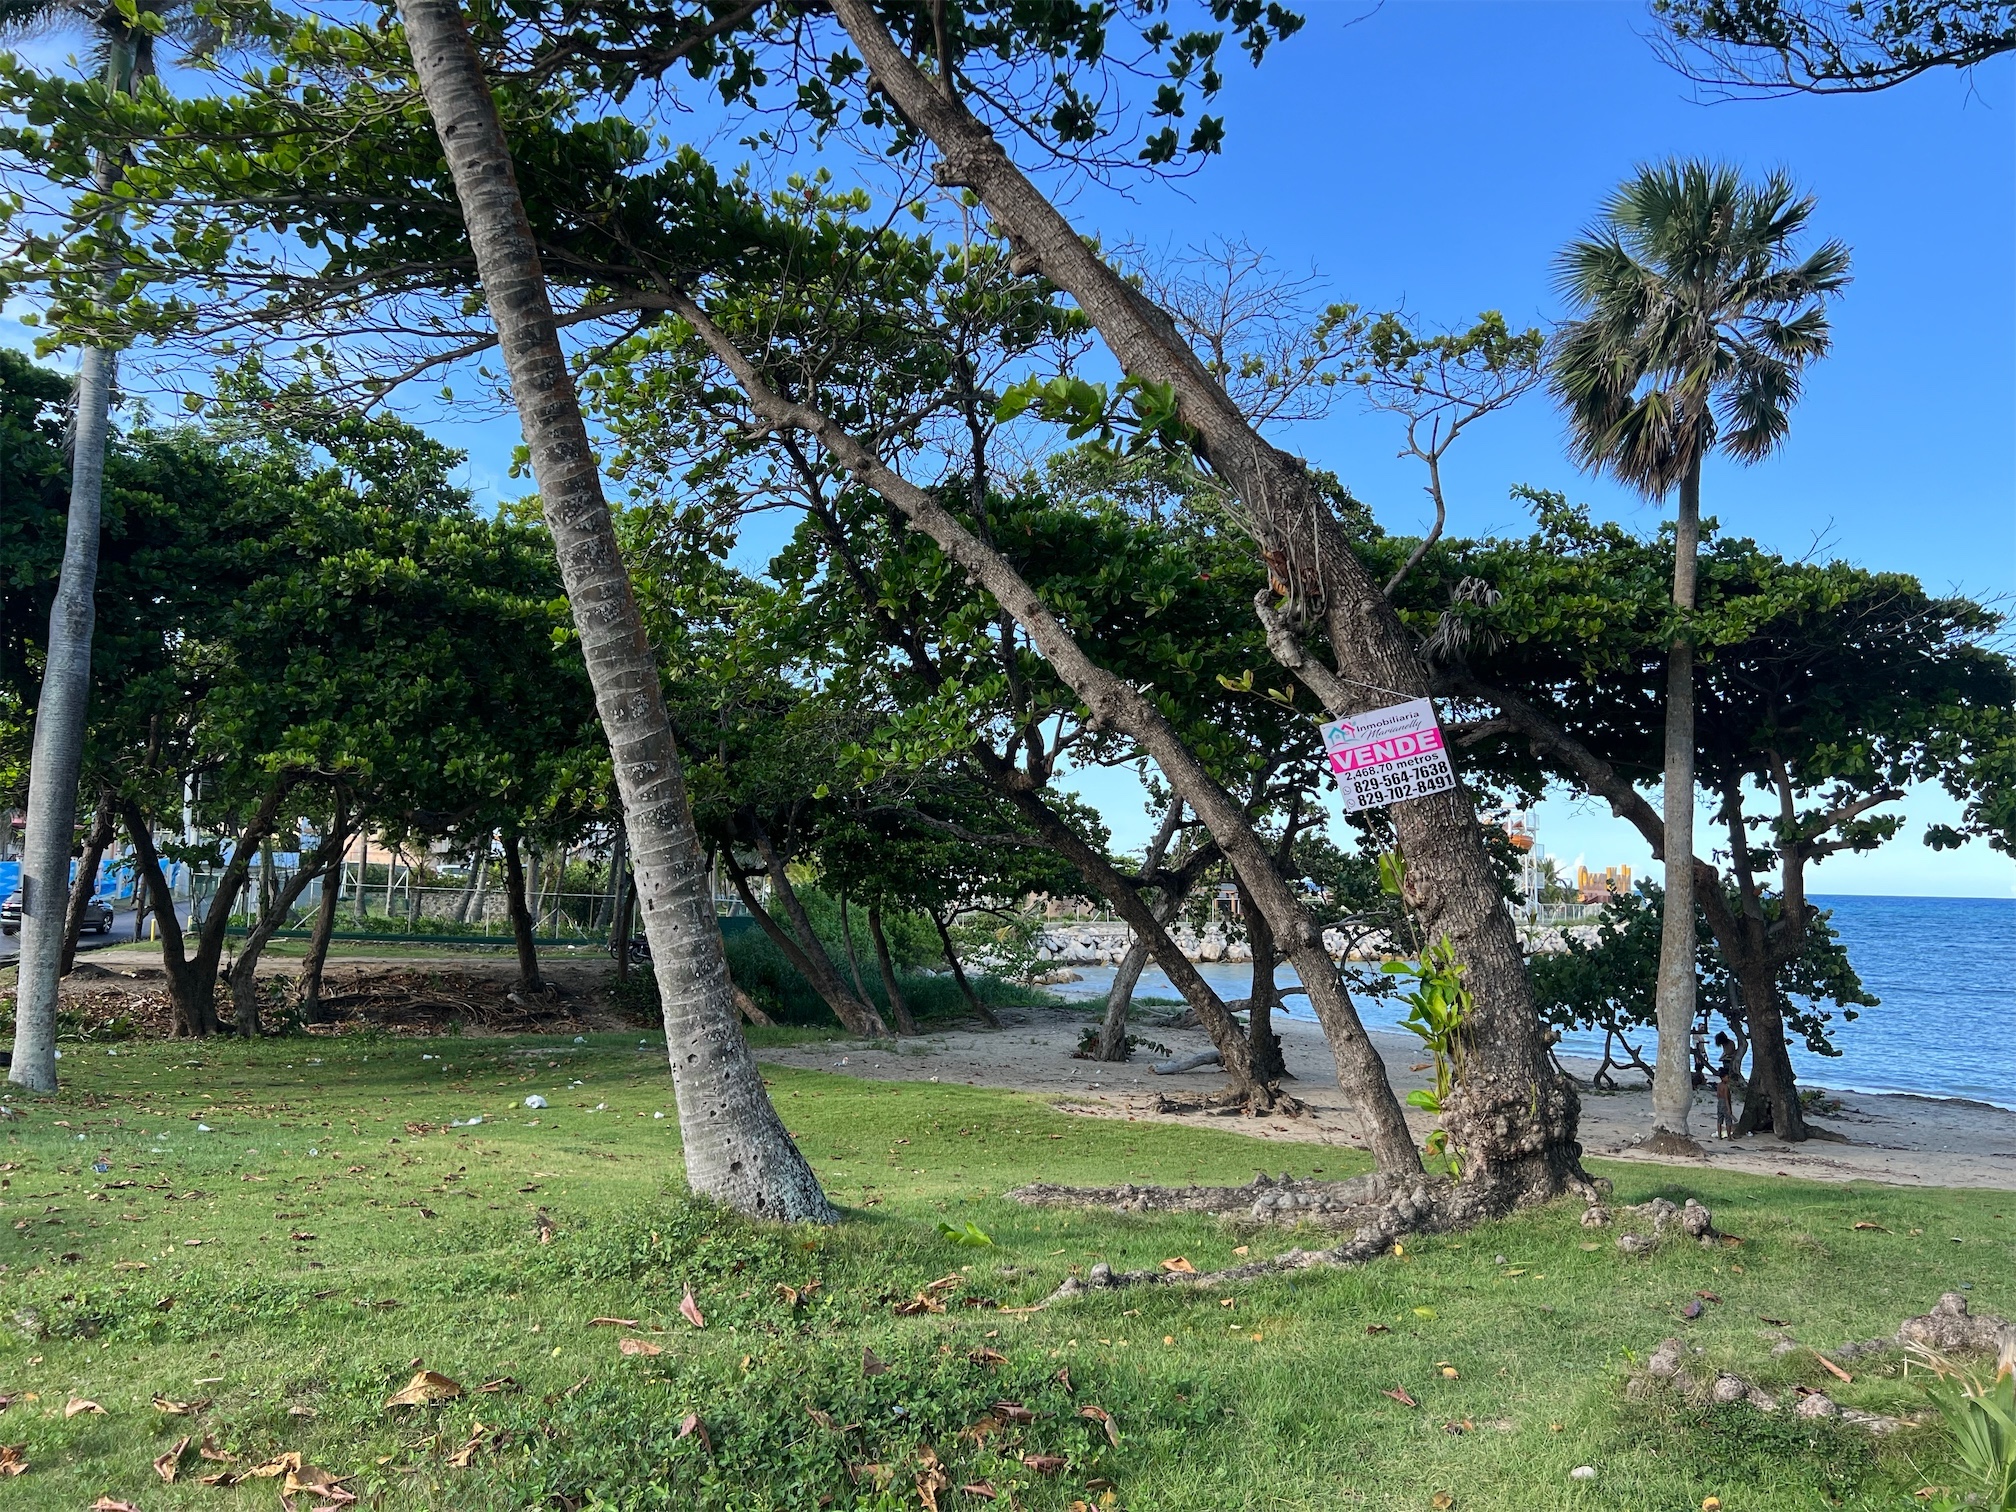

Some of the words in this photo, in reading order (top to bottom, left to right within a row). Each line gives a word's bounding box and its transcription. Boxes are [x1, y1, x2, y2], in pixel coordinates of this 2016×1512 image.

[1356, 711, 1420, 732] Inmobiliaria
[1360, 718, 1422, 740] Marianelly
[1334, 731, 1436, 770] VENDE
[1345, 762, 1393, 781] 2,468.70
[1396, 753, 1439, 769] metros
[1354, 761, 1448, 794] 829-564-7638
[1357, 774, 1454, 806] 829-702-8491
